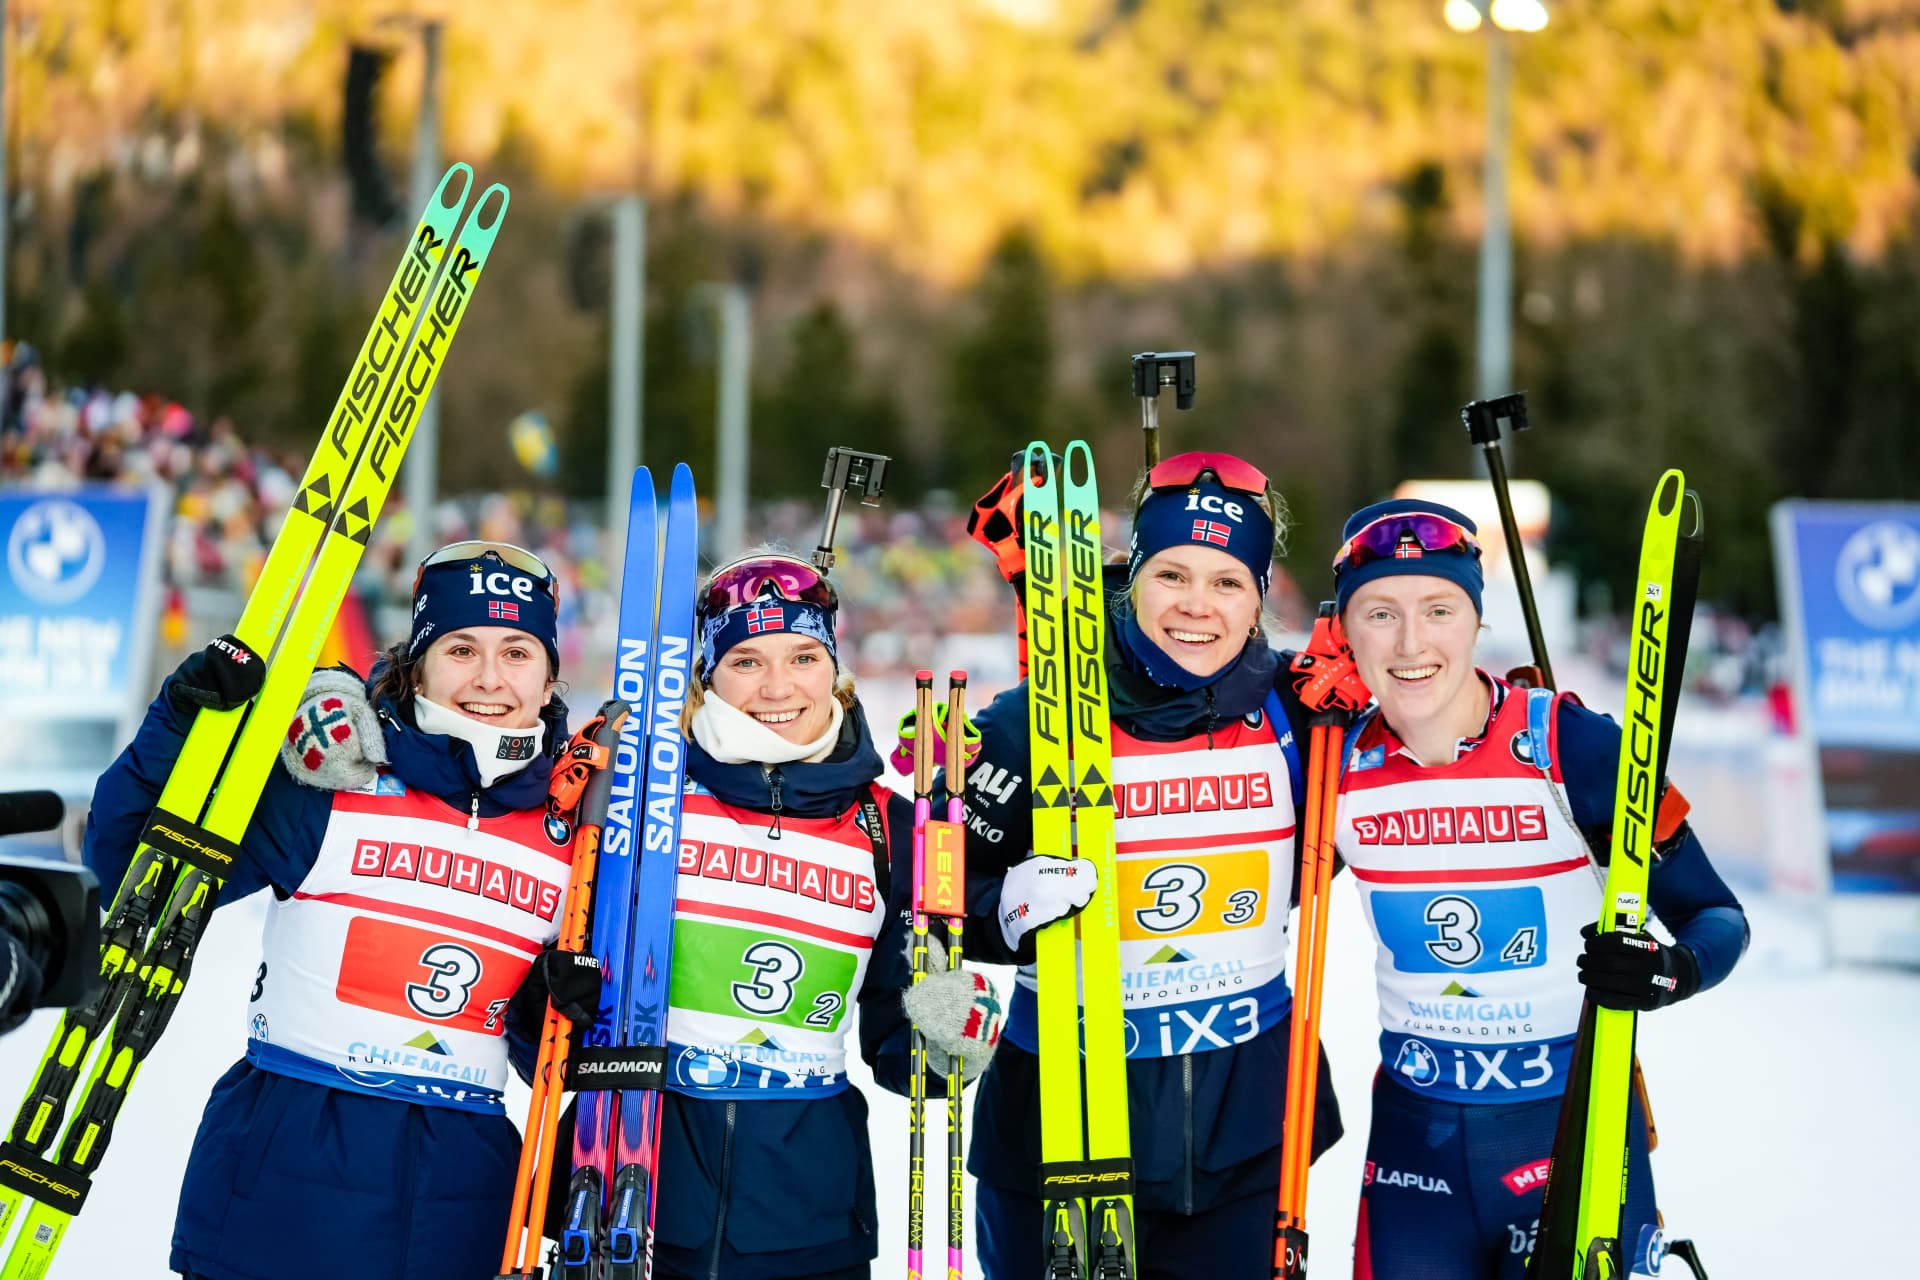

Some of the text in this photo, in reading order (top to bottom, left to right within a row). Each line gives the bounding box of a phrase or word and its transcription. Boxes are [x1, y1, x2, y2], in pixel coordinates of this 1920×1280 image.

[332, 225, 443, 460] FISCHER
[370, 247, 479, 483] FISCHER
[1185, 488, 1244, 523] ice
[469, 564, 533, 602] ice
[1029, 509, 1060, 745] FISCHER
[1071, 508, 1102, 744] FISCHER
[209, 638, 251, 664] NETIXX
[500, 736, 535, 748] NOVA
[603, 638, 647, 857] SALOMON
[645, 636, 688, 854] SALOMON
[1623, 601, 1664, 867] FISCHER
[1113, 779, 1269, 812] UHAUS
[151, 824, 234, 865] FISCHER
[1358, 810, 1544, 843] BAUHAUS
[357, 844, 559, 917] BAUHAUS
[679, 845, 875, 906] BAUHAUS
[936, 828, 952, 906] LEKI
[1135, 863, 1258, 932] 3 3
[1424, 894, 1538, 968] 3 4
[405, 943, 481, 1019] 3
[574, 955, 601, 969] KINET
[732, 941, 842, 1025] 3 2
[1122, 959, 1244, 989] HIEMGAU
[1125, 975, 1244, 1002] HPOLDING
[1159, 997, 1260, 1056] iX3
[1408, 1000, 1531, 1022] CHIEMGAU
[578, 1061, 663, 1075] SALOMON
[1454, 1045, 1554, 1090] iX3
[0, 1159, 81, 1199] FISCHER
[1044, 1171, 1130, 1185] FISCHER
[1376, 1167, 1453, 1195] LAPUA
[1513, 1164, 1549, 1188] ME
